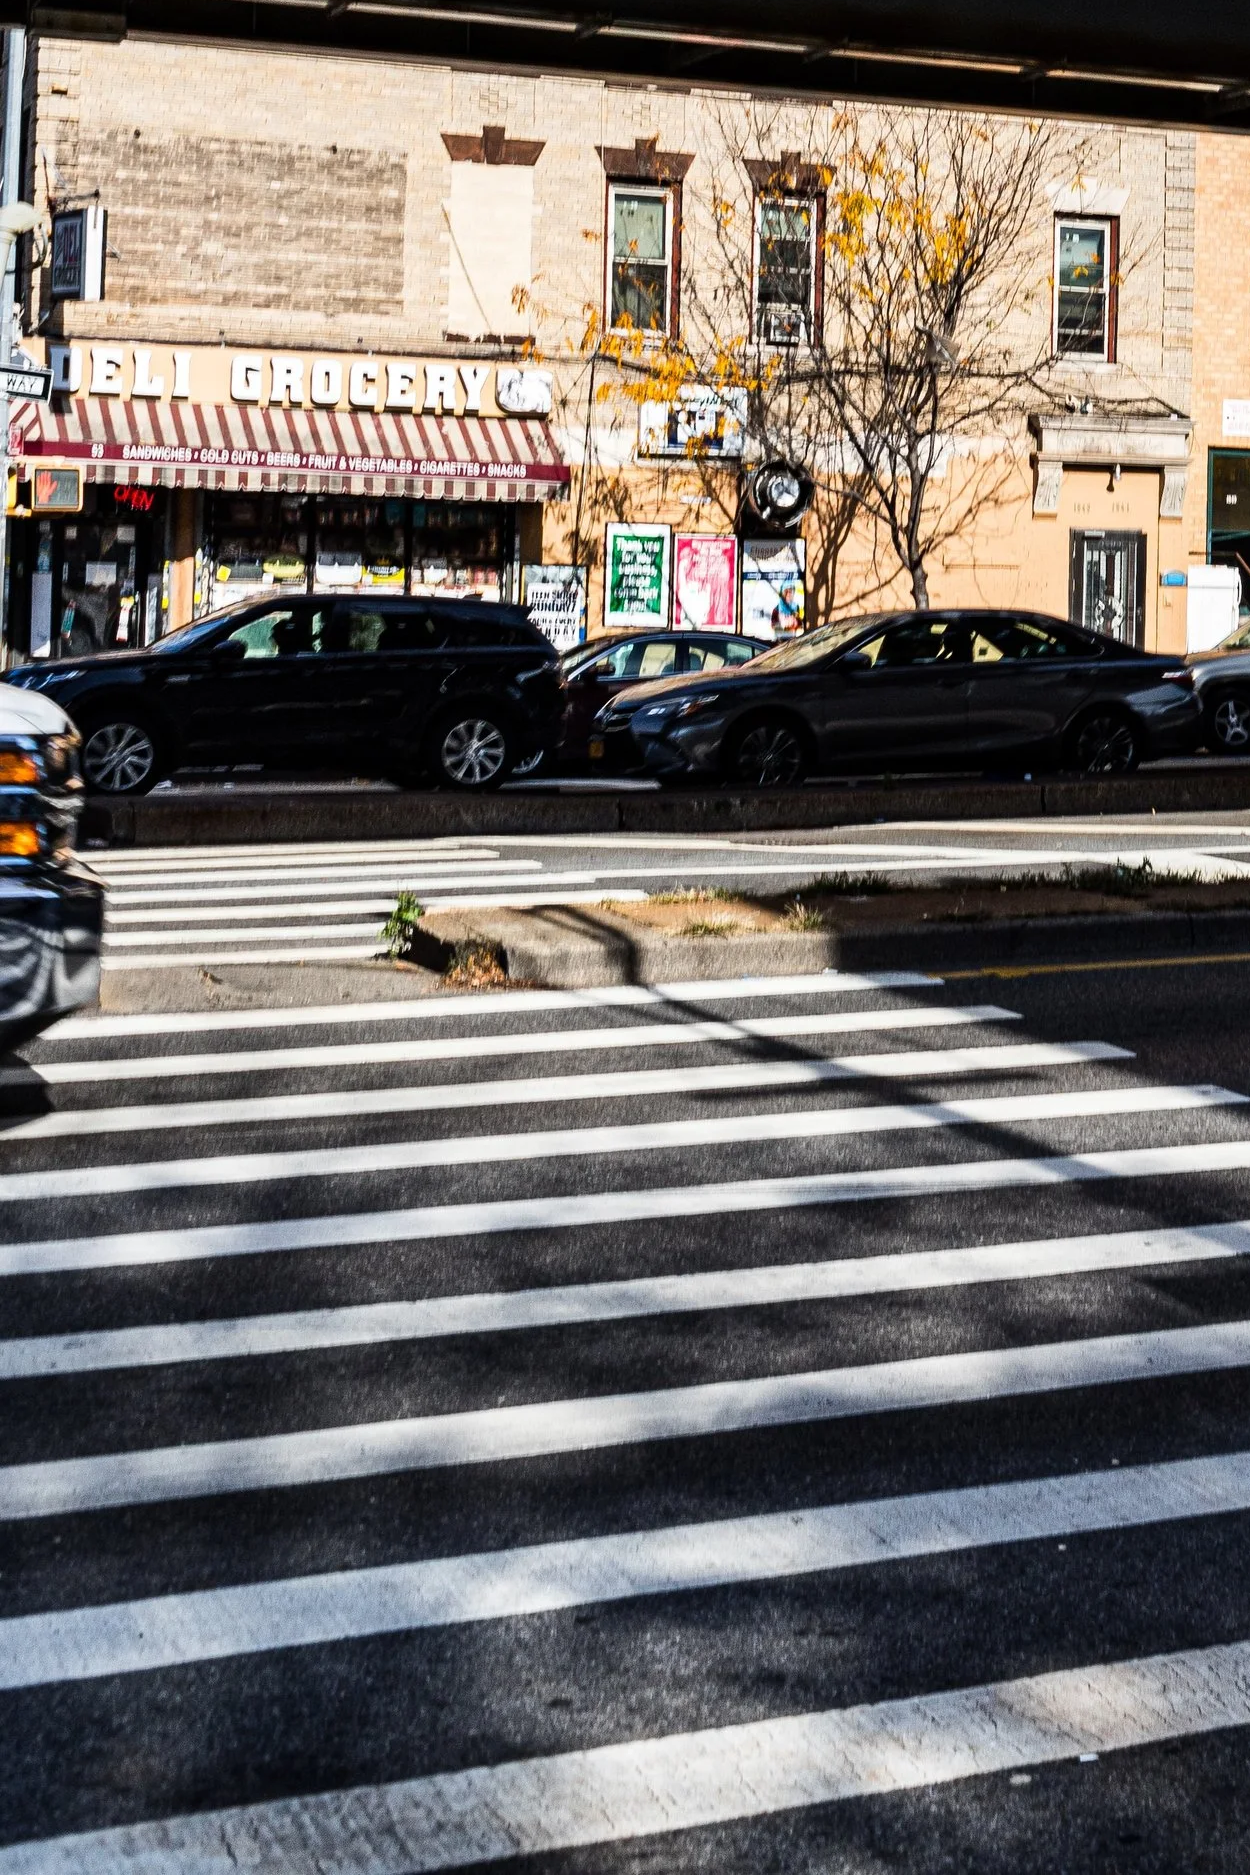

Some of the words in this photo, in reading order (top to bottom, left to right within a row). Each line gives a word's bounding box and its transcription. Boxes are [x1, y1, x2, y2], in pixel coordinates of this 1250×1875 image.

[6, 373, 37, 393] WAY
[50, 346, 192, 399] DELI
[231, 355, 491, 412] GROCERY
[123, 445, 192, 462] SANDWICHES
[200, 448, 229, 465] COLD
[231, 450, 258, 466] CUTS
[266, 452, 300, 468] BEERS
[308, 454, 337, 469] FRUIT
[339, 456, 346, 471] &
[349, 457, 413, 474] VEGETABLES
[420, 461, 480, 477] CIGARETTES
[487, 464, 527, 478] SNACKS
[616, 537, 643, 552] Thank
